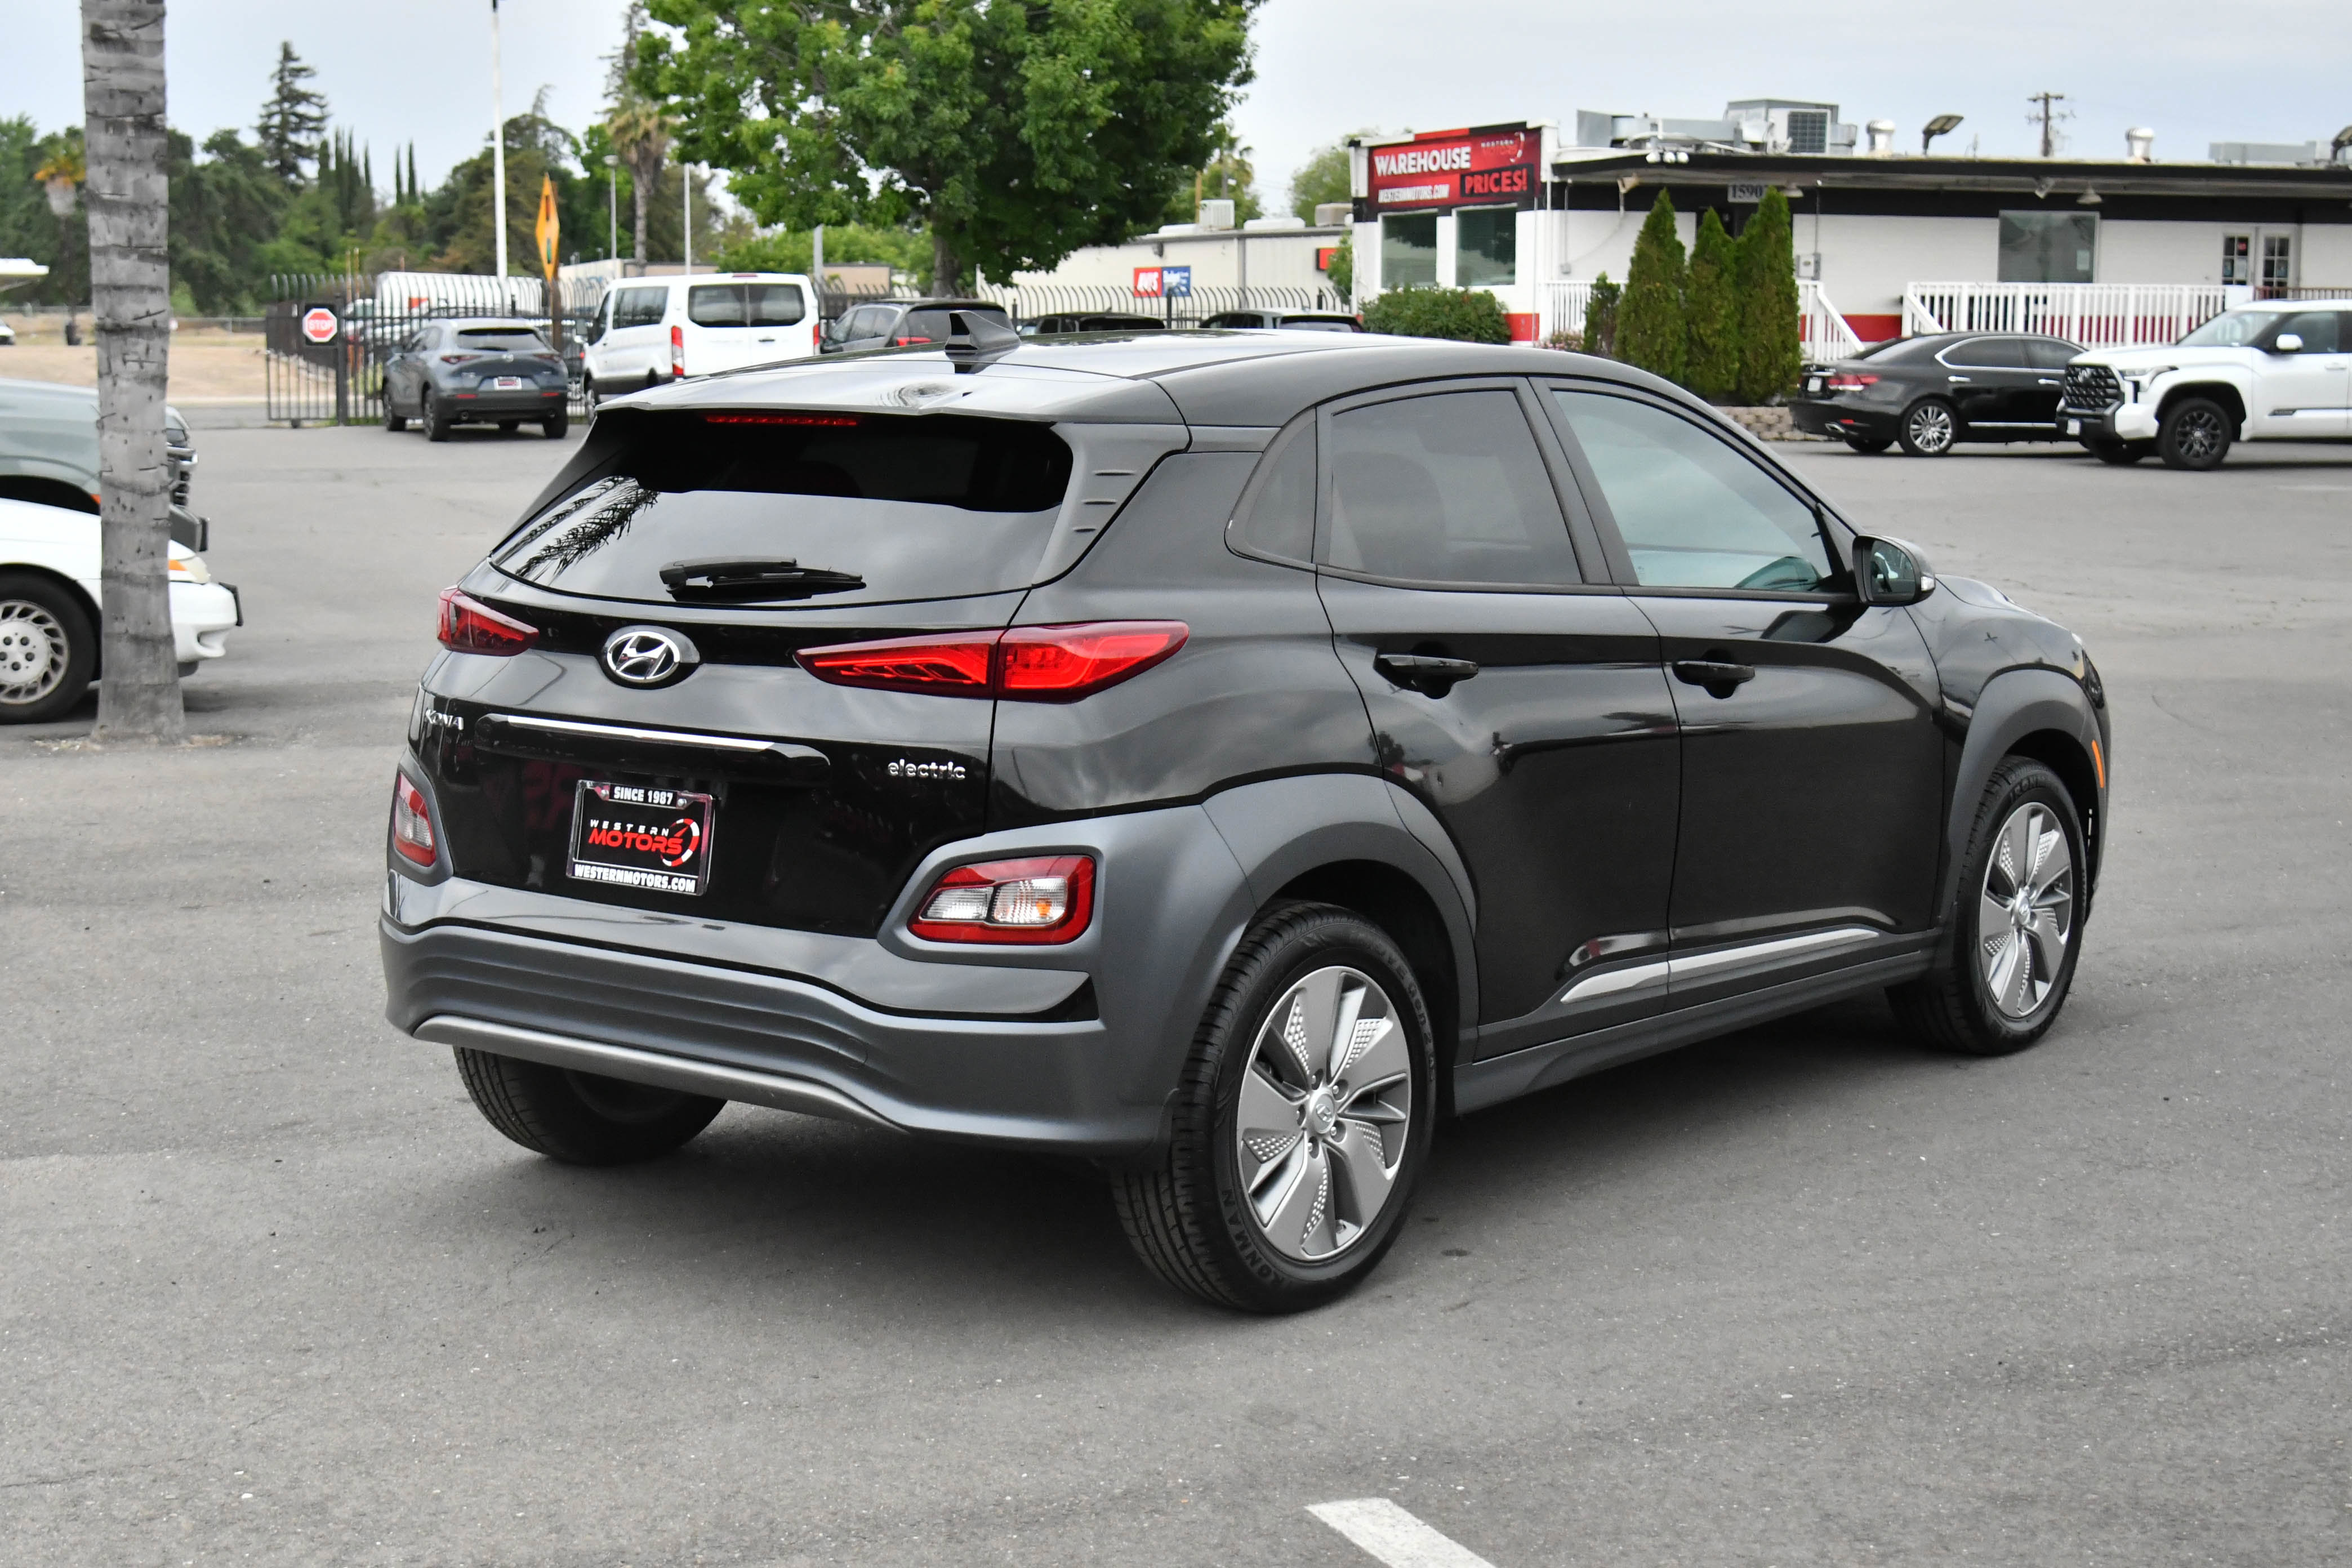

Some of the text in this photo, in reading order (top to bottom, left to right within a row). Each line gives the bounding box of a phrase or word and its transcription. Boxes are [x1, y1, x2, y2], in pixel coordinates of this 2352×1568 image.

[1374, 146, 1472, 176] WAREHOUSE
[1465, 168, 1528, 194] PRICES!
[308, 319, 334, 330] STOP
[888, 759, 966, 780] electric
[613, 786, 673, 805] SINCE 1987
[590, 819, 669, 837] WESTERN
[588, 827, 683, 856] MOTORS
[574, 864, 696, 893] WESTERNMOTORS.COM
